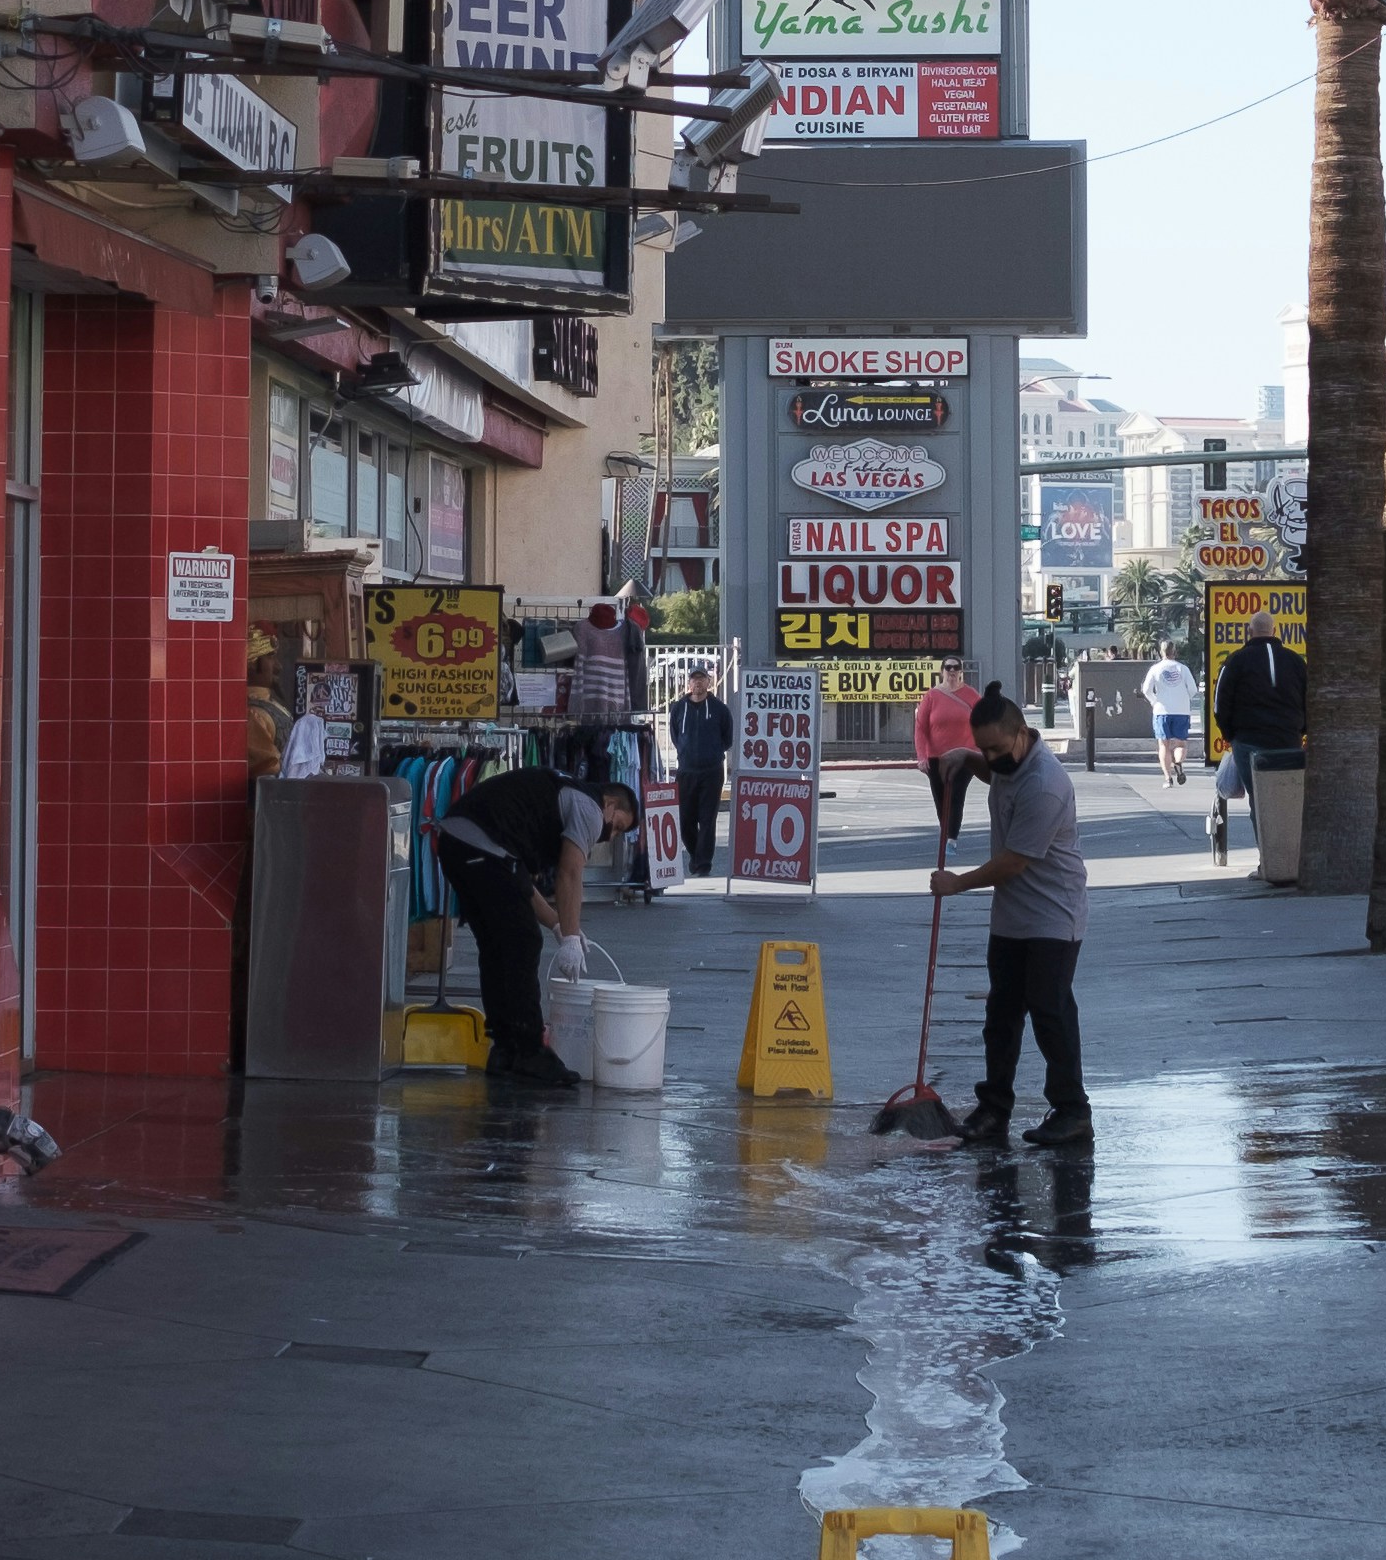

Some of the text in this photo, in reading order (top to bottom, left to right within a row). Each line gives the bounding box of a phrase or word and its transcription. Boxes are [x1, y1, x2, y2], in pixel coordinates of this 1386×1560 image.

[753, 0, 865, 49] Yama
[798, 67, 837, 78] DOSA
[842, 67, 851, 78] &
[857, 67, 915, 78] BIRYANI
[931, 78, 961, 88] HALAL
[771, 85, 905, 116] NDIAN
[944, 90, 975, 99] VEGAN
[931, 101, 988, 111] VEGETARIAN
[210, 74, 263, 171] TIJUANA
[794, 121, 865, 134] CUISINE
[929, 113, 990, 123] GLUTEN FREE
[937, 125, 960, 135] FULL
[458, 134, 595, 187] FRUITS
[776, 350, 965, 374] SMOKE SHOP
[802, 393, 933, 428] Luna LOUNGE
[812, 446, 928, 464] WELCOME
[811, 471, 925, 489] LAS VEGAS
[1199, 498, 1261, 521] TACOS
[792, 522, 802, 552] VEGAS
[806, 521, 945, 553] NAIL SPA
[1052, 522, 1102, 540] LOVE
[1220, 522, 1240, 543] EL
[1199, 545, 1267, 569] GORDO
[175, 559, 228, 578] WARNING
[781, 564, 957, 607] LIQUOR
[1214, 591, 1306, 616] FOOD DRU
[780, 612, 870, 649] 김치
[1279, 622, 1307, 645] WIN
[391, 668, 493, 680] HIGH FASHION
[844, 662, 871, 672] GOLD
[874, 662, 883, 672] &
[396, 682, 488, 695] SUNGLASSES
[745, 674, 812, 690] LAS VEGAS
[819, 671, 943, 692] E BUY GOLD
[420, 706, 464, 715] 2 for $10
[745, 692, 811, 711] T-SHIRTS
[744, 711, 811, 739] 3 FOR
[743, 739, 812, 769] $9.99
[740, 781, 811, 799] EVERYTHING
[741, 800, 805, 858] $10
[742, 859, 801, 879] OR LESS!
[775, 974, 808, 982] CAUTION
